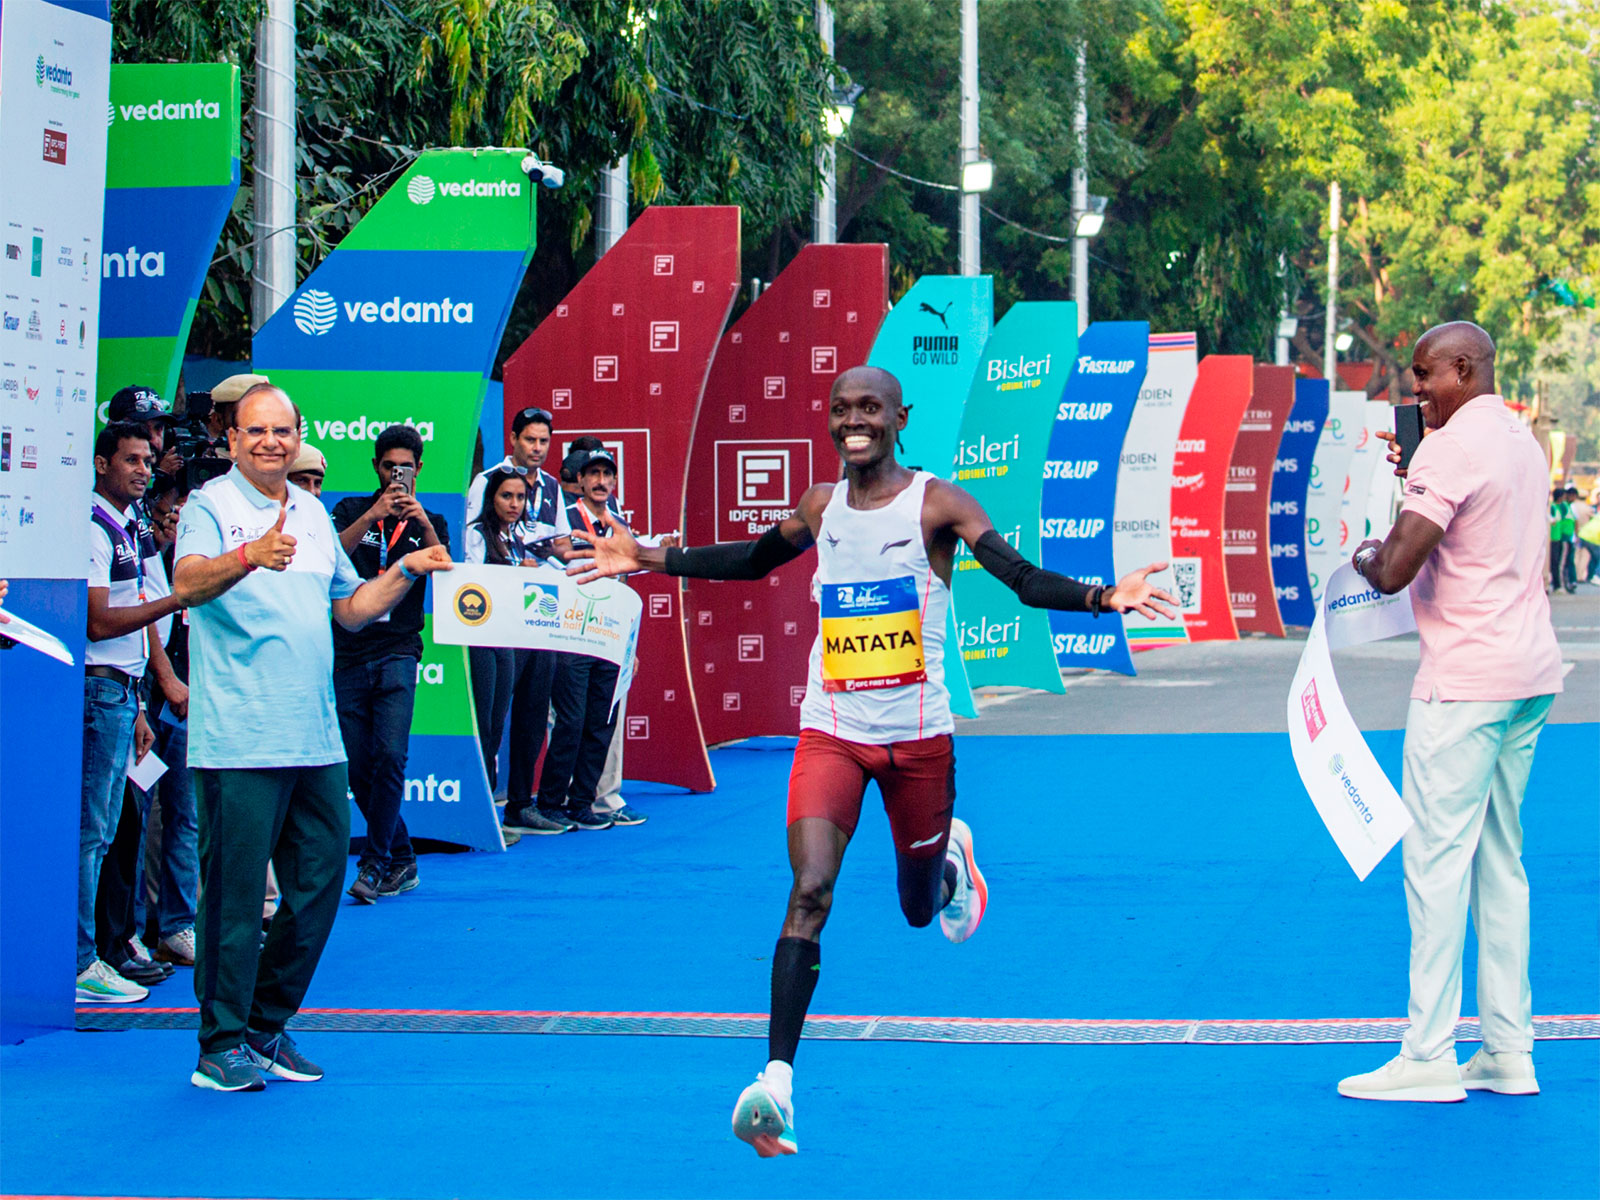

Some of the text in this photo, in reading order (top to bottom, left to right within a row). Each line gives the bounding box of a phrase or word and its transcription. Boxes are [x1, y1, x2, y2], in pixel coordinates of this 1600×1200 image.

[46, 64, 72, 86] vedanta
[120, 100, 220, 122] vedanta
[439, 180, 521, 197] vedanta
[344, 297, 473, 323] vedanta
[913, 336, 958, 351] PUMA
[912, 352, 958, 365] GO WILD
[987, 354, 1051, 382] Bisleri
[1078, 356, 1135, 374] FAST&UP
[1056, 402, 1113, 420] ST&UP
[314, 415, 434, 441] vedaa
[953, 433, 1020, 466] isleri
[1042, 460, 1099, 479] ST&UP
[729, 510, 759, 521] IDFC
[1114, 520, 1160, 532] ERIDIEN
[524, 618, 560, 628] vedanta
[956, 616, 1020, 647] isleri
[826, 630, 917, 654] MATATA
[1052, 634, 1116, 655] ST&UP
[915, 659, 922, 668] 3
[886, 678, 901, 686] Bank
[1340, 771, 1374, 824] vedanta
